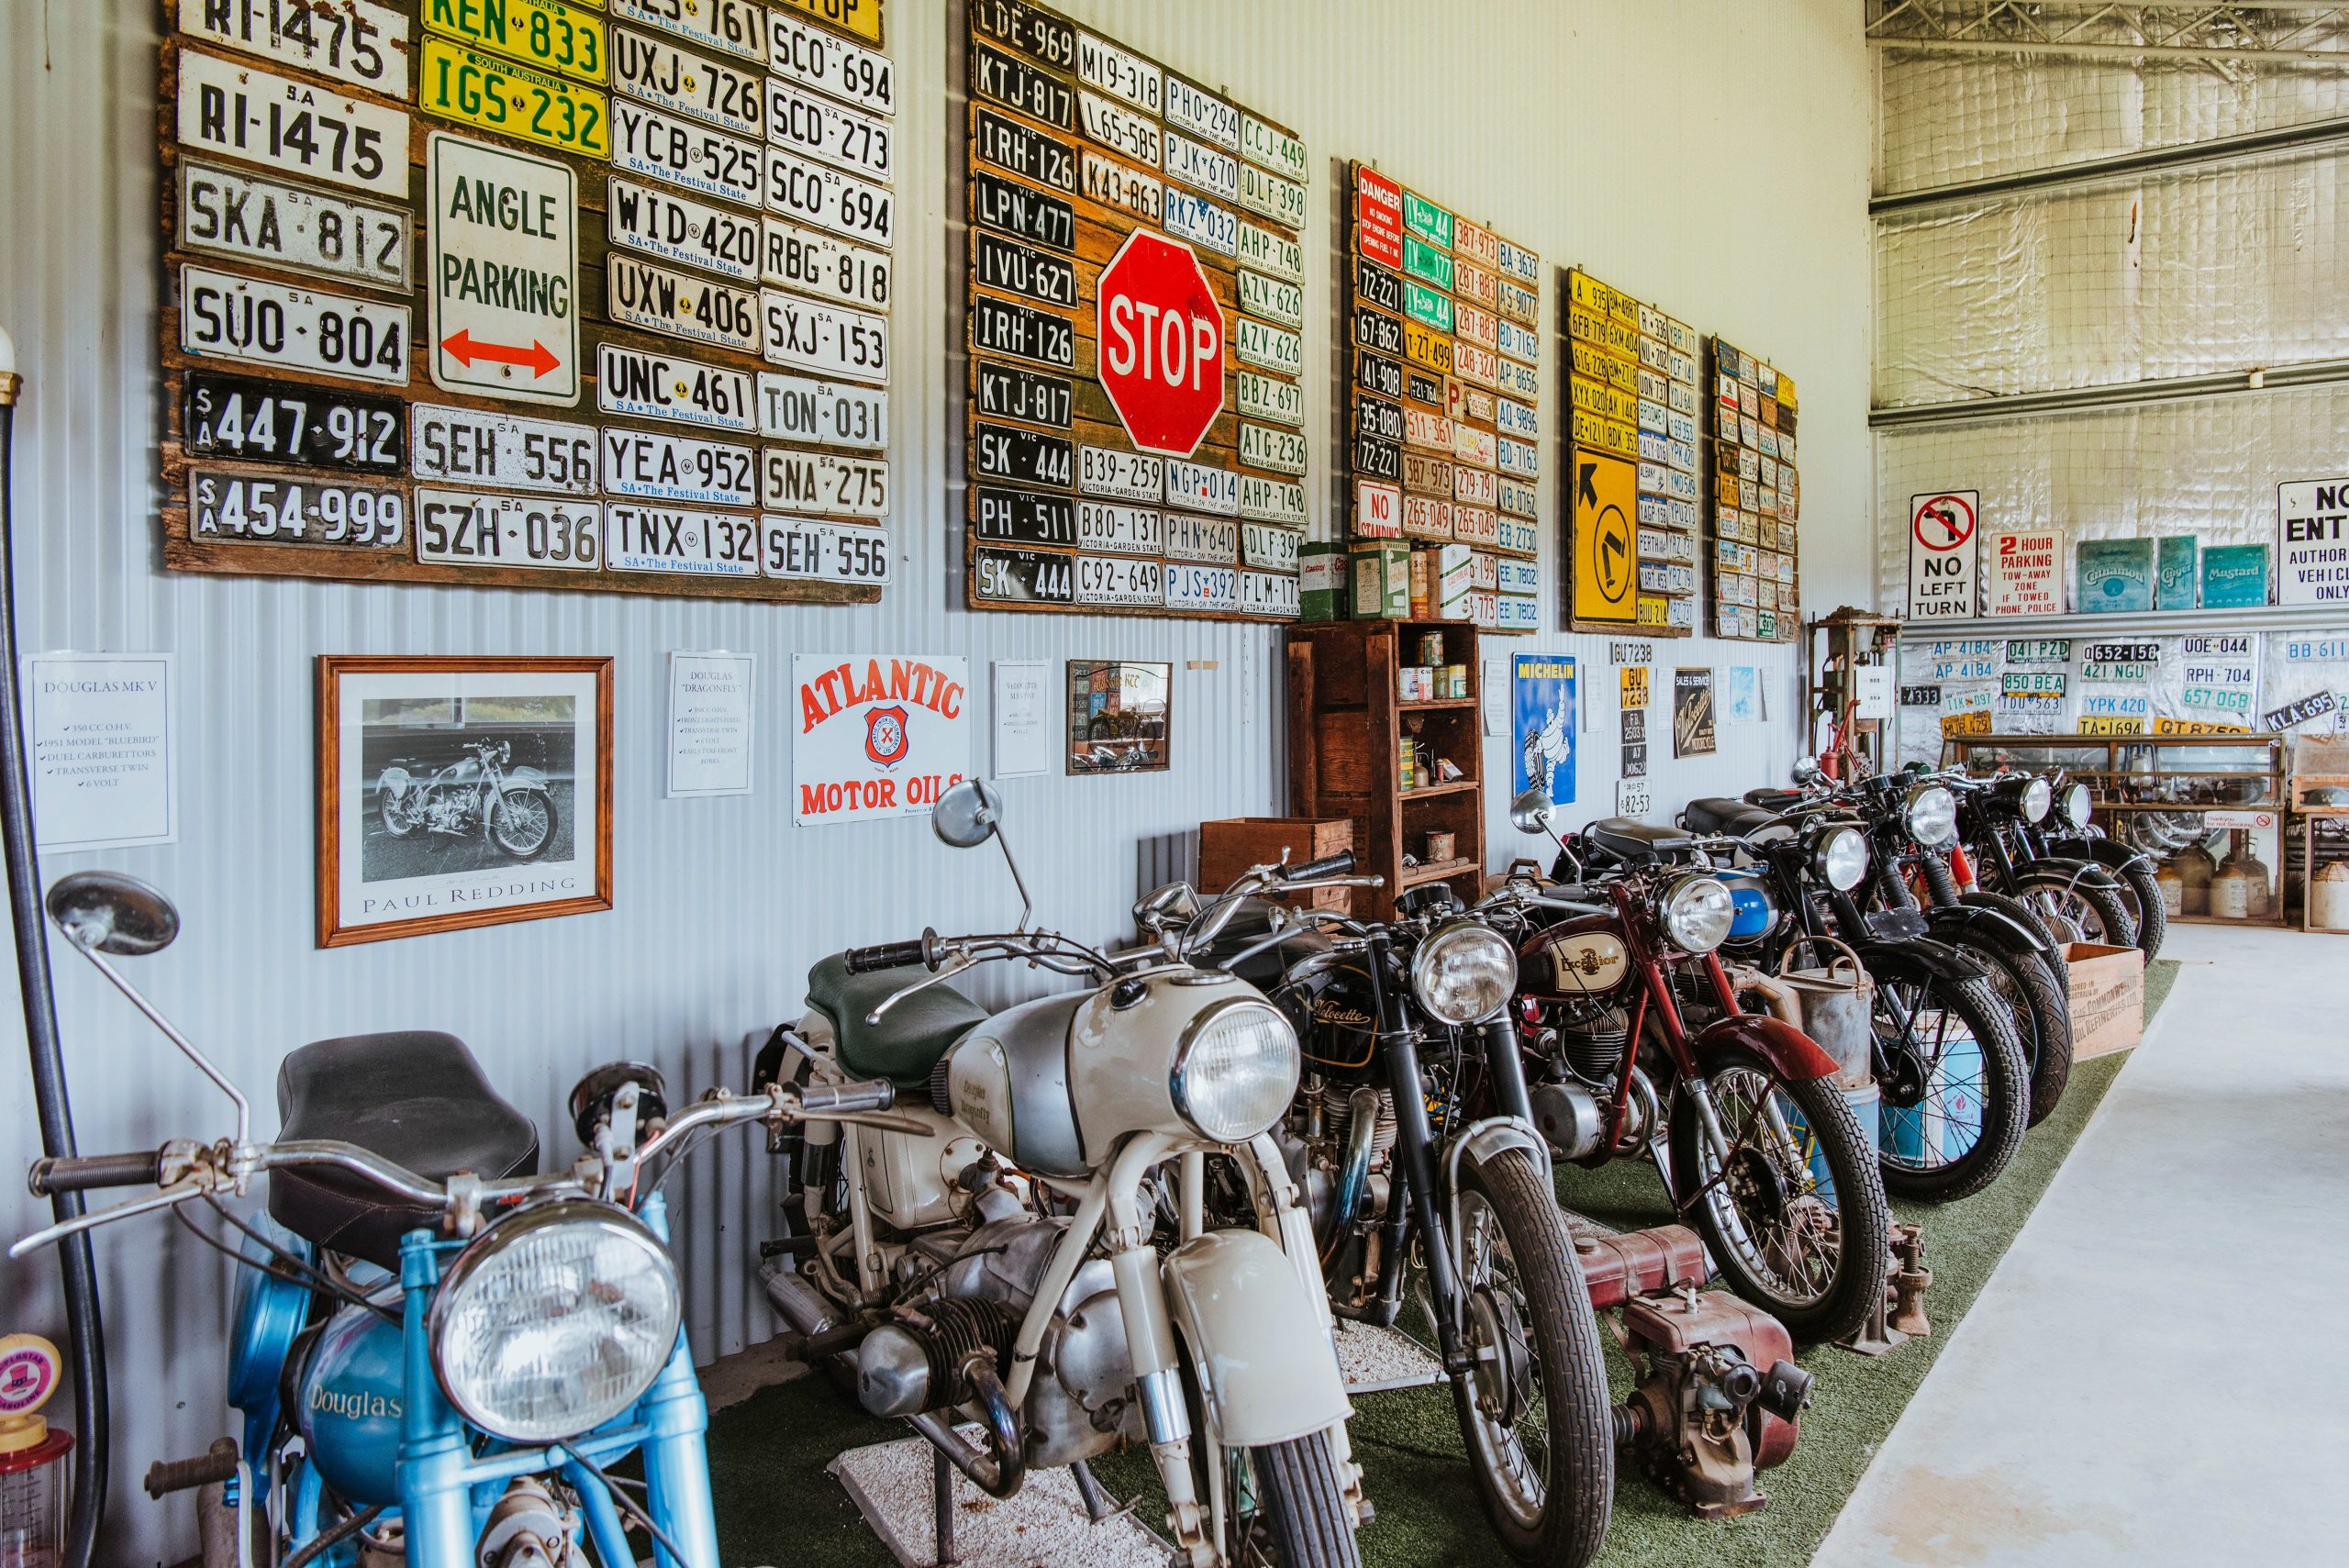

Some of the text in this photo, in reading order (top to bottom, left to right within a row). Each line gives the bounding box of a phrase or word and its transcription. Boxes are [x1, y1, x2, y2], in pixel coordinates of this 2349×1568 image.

[529, 10, 597, 72] 833
[474, 56, 562, 93] SOUTH AUSTRALIA
[1082, 44, 1158, 109] M19-318
[437, 56, 602, 151] IGS 232
[200, 83, 384, 181] RI-1475
[674, 171, 718, 192] Festival
[720, 183, 747, 201] State
[1360, 176, 1400, 212] DANGER
[450, 175, 558, 240] ANGLE
[1168, 222, 1190, 237] VICTORIA
[442, 253, 569, 319] PARKING
[1108, 294, 1217, 391] STOP
[1448, 382, 1459, 415] P
[1085, 450, 1160, 489] B39-259
[666, 486, 712, 501] Festival
[714, 491, 740, 503] State
[1142, 491, 1160, 500] STATE
[1371, 493, 1389, 520] NO
[1082, 506, 1158, 543] B80-137
[1999, 536, 2053, 555] 2 HOUR
[1305, 563, 1326, 573] Castrol
[1924, 557, 1962, 578] NO
[2001, 554, 2052, 569] PARKING
[1082, 561, 1158, 593] C92-649
[2001, 570, 2052, 581] TOW-AWAY
[2161, 564, 2193, 588] Ginger
[2208, 566, 2260, 582] Mustard
[1920, 582, 1967, 596] LEFT
[2014, 582, 2038, 592] ZONE
[2002, 592, 2049, 603] IF TOWED
[1915, 600, 1966, 616] TURN
[1995, 603, 2056, 615] PHONE POLICE
[690, 672, 733, 681] DOUGLAS
[1519, 662, 1574, 679] MICHELIN
[44, 682, 119, 694] DOUGLAS
[800, 659, 964, 734] ATLANTIC
[89, 723, 104, 732] CC
[66, 738, 103, 747] MODEL
[47, 749, 156, 762] DUEL CARBURETTORS
[55, 763, 149, 775] TRANSVERSE TWIN
[94, 779, 120, 787] VOLT
[800, 778, 897, 815] MOTOR
[362, 877, 576, 914] PAUL REDDING
[1560, 953, 1620, 973] Excelsior
[1314, 998, 1371, 1024] Velocette
[310, 1383, 403, 1418] Douglas
